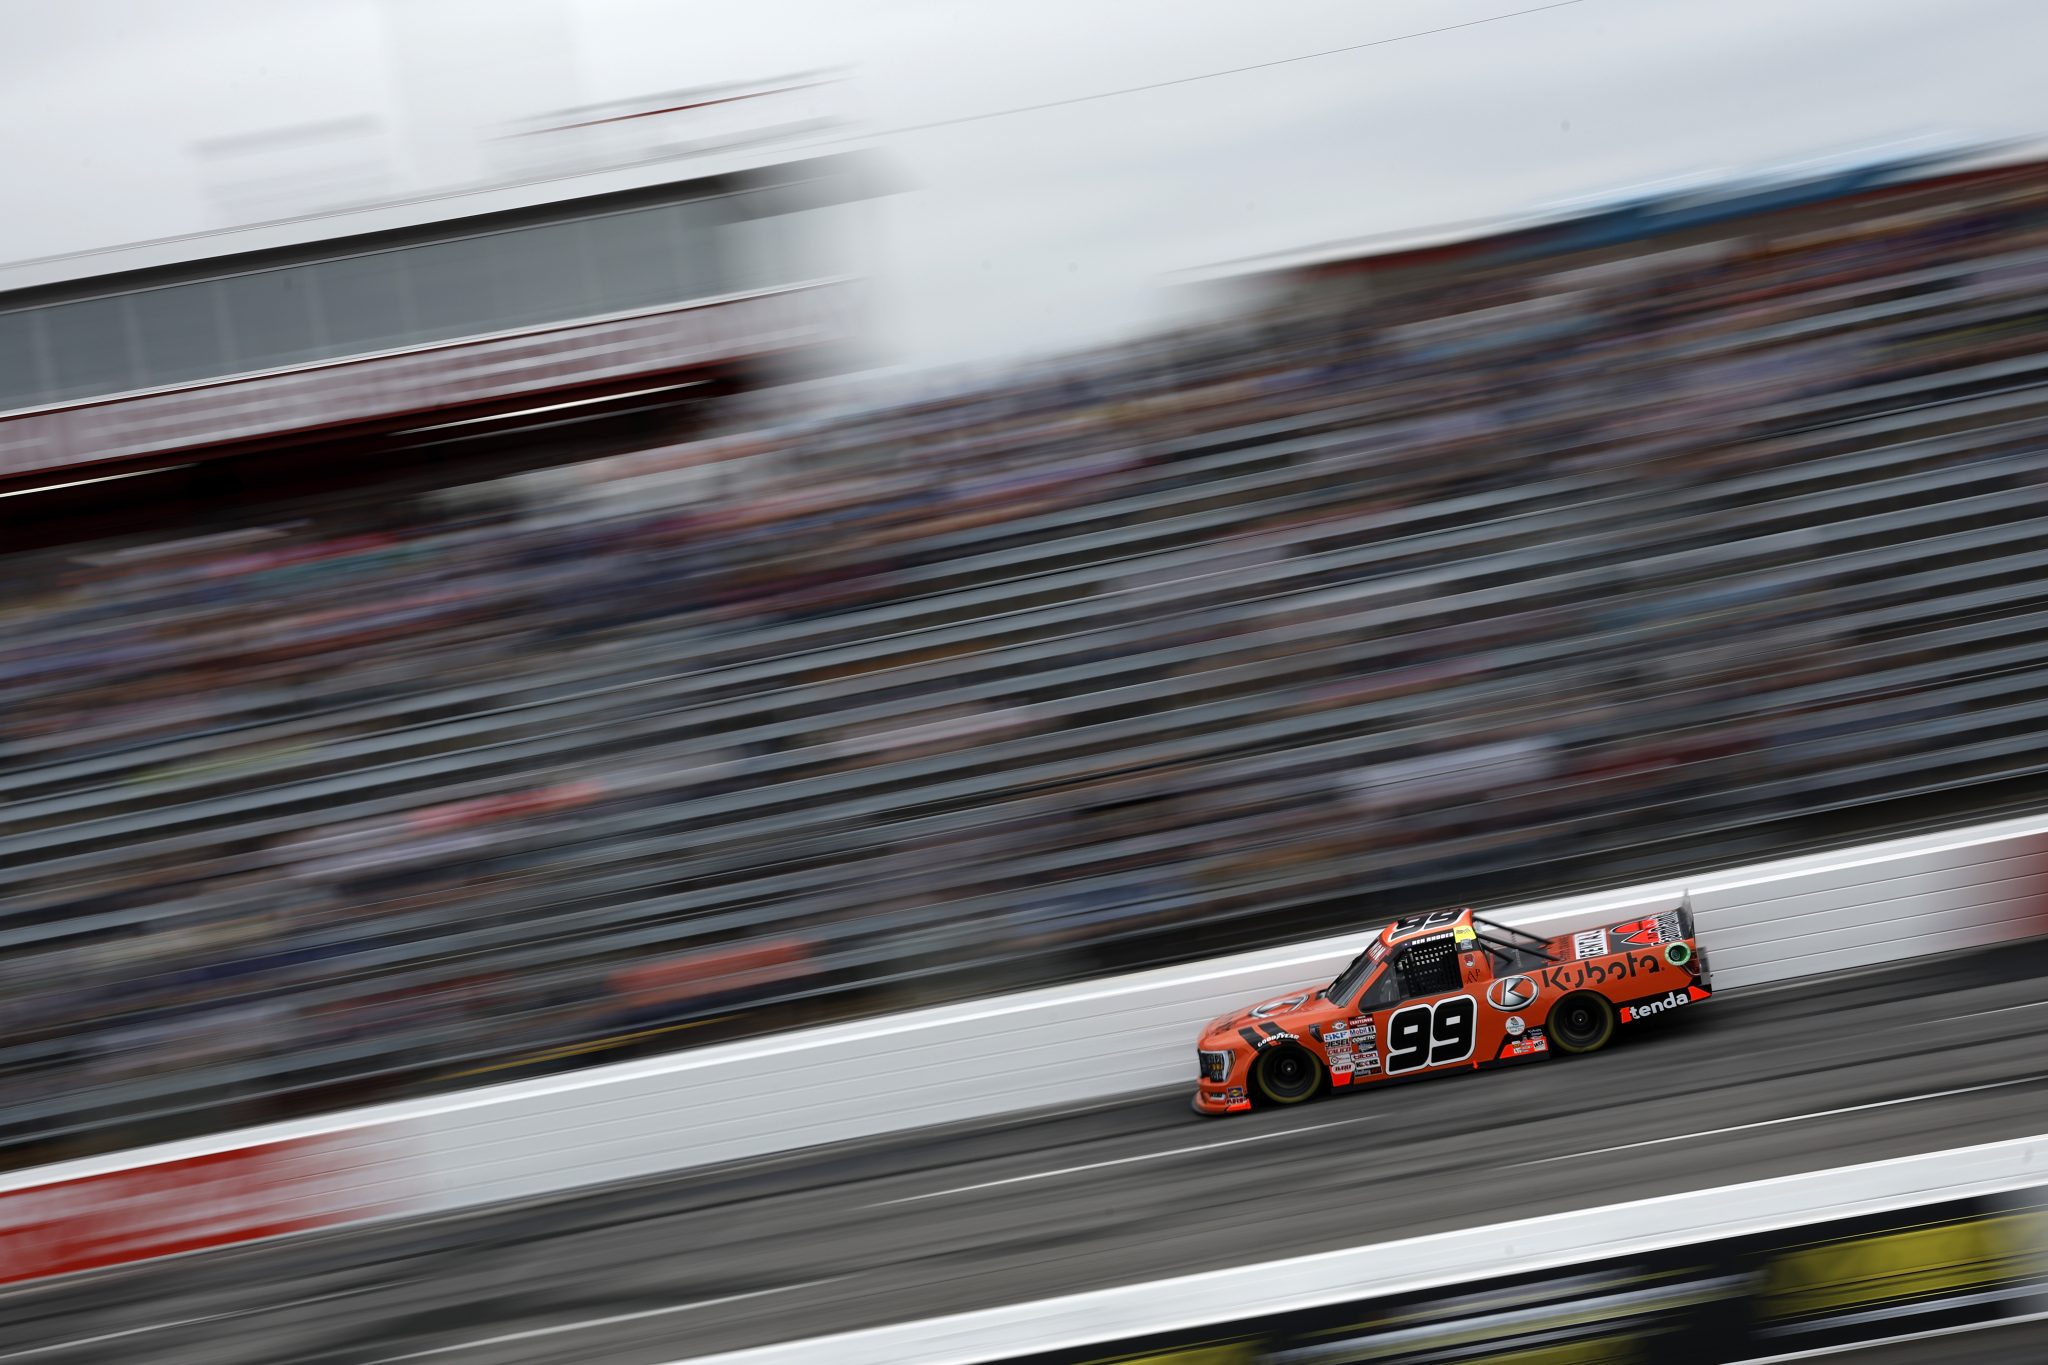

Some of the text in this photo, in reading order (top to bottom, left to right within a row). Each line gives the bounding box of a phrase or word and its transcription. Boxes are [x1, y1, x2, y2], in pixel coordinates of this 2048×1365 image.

[1541, 951, 1660, 991] Kubota
[1629, 991, 1689, 1019] tenda
[1257, 1032, 1300, 1047] GOODYEAR
[1325, 1031, 1347, 1041] SKF
[1325, 1039, 1351, 1048] JESEL
[1386, 994, 1478, 1076] 99
